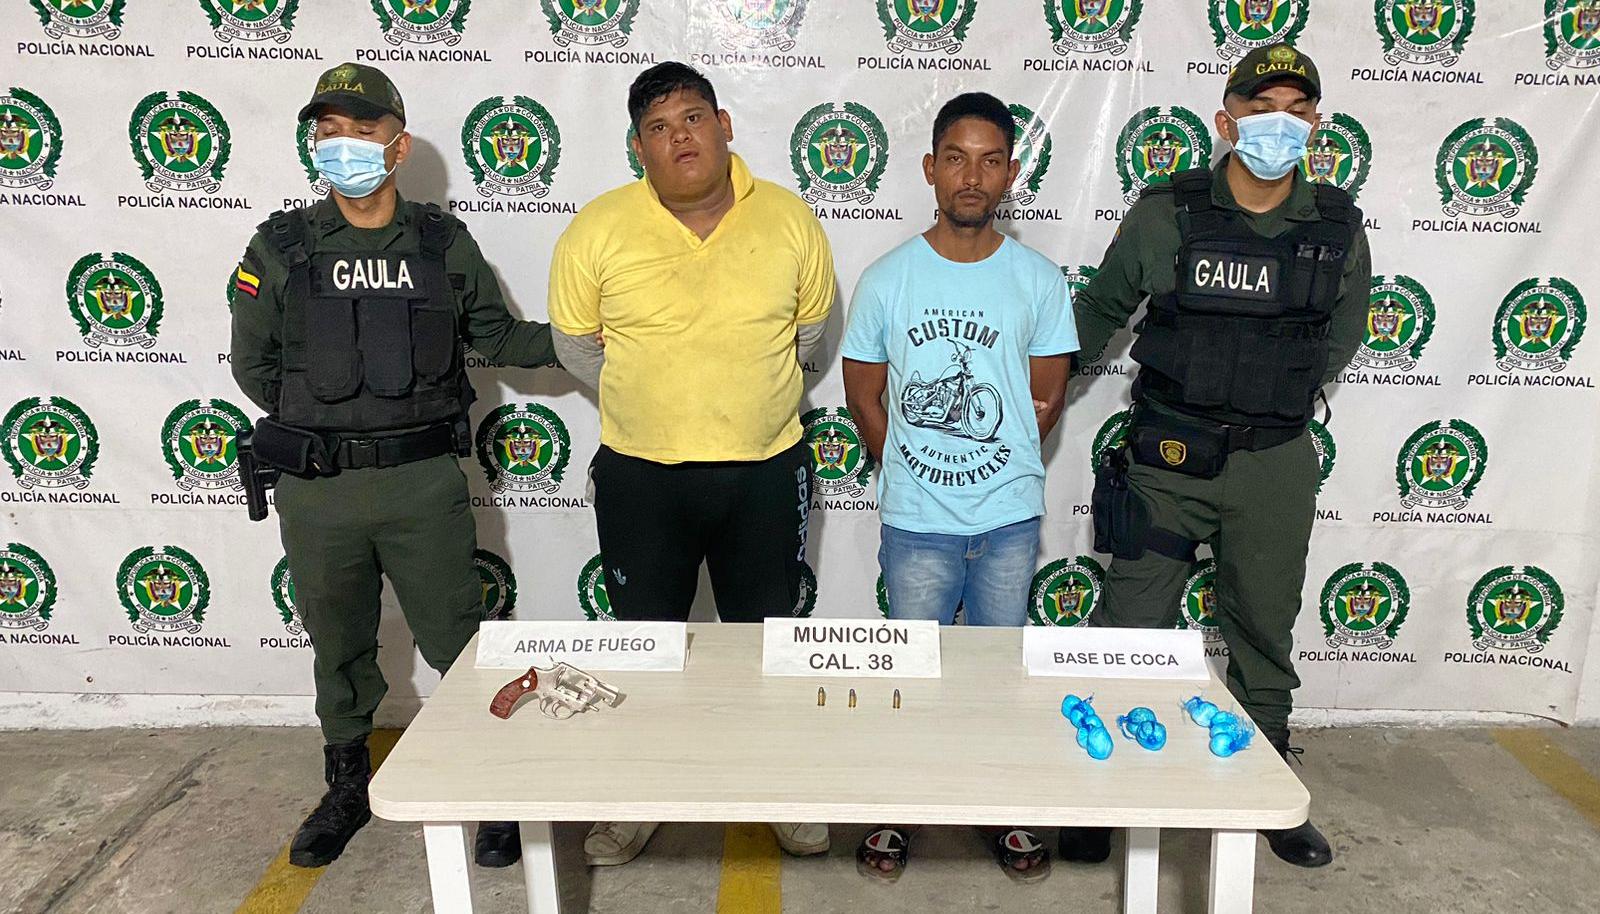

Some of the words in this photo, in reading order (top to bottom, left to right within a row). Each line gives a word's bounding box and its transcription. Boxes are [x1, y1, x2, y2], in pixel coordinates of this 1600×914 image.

[18, 38, 76, 55] POLICÍA
[79, 44, 154, 57] NACIONAL
[187, 41, 245, 58] POLICÍA
[248, 47, 323, 60] NACIONAL
[356, 47, 415, 61] POLICÍA
[419, 50, 491, 61] NACIONAL
[525, 48, 581, 62] POLICÍA
[585, 52, 660, 66] NACIONAL
[858, 53, 914, 69] POLICÍA
[918, 58, 991, 70] NACIONAL
[1024, 55, 1079, 71] POLICÍA
[1083, 60, 1154, 72] NACIONAL
[1187, 60, 1234, 74] POLICÍ
[1256, 63, 1306, 75] GAULA
[1351, 67, 1407, 81] POLICÍA
[1412, 71, 1483, 83] NACIONAL
[1515, 73, 1569, 85] POLICÍA
[140, 106, 164, 138] REPUBLICA
[187, 105, 217, 138] COLOMBIA
[474, 110, 499, 142] REPUBLICA
[522, 110, 548, 142] COLOMBIA
[802, 117, 828, 149] REPUBLICA
[851, 116, 876, 149] COLOMBIA
[150, 158, 176, 178] POLICIA
[184, 158, 215, 179] NACIONAL
[481, 164, 506, 182] POLICIA
[514, 163, 544, 183] NACIONAL
[154, 177, 171, 188] DIOS
[186, 178, 212, 188] PATRIA
[808, 170, 832, 189] POLICIA
[840, 169, 871, 190] NACIONAL
[516, 183, 541, 192] PATRIA
[810, 188, 826, 198] DIOS
[842, 190, 866, 200] PATRIA
[12, 194, 86, 206] NACIONAL
[118, 194, 175, 208] POLICÍA
[179, 197, 251, 209] NACIONAL
[447, 200, 504, 214] POLICÍA
[508, 202, 578, 213] NACIONAL
[832, 208, 903, 220] NACIONAL
[993, 209, 1062, 220] NACIONAL
[1412, 218, 1467, 232] POLICÍA
[1472, 222, 1541, 233] NACIONAL
[333, 260, 413, 290] GAULA
[1194, 259, 1270, 293] GAULA
[924, 308, 984, 318] AMERICAN
[907, 318, 1000, 349] CUSTOM
[56, 351, 112, 362] POLICÍA
[116, 352, 187, 363] NACIONAL
[1079, 365, 1126, 376] CIONAL
[1333, 372, 1368, 384] LICÍA
[1373, 374, 1441, 385] NACIONAL
[1468, 371, 1520, 385] POLICÍA
[1524, 376, 1595, 387] NACIONAL
[11, 410, 36, 439] REPUBLICA
[921, 445, 988, 463] AUTHENTIC
[20, 459, 45, 476] POLICIA
[55, 457, 83, 476] NACIONAL
[900, 444, 1011, 486] MOTORCYCLES
[25, 475, 41, 484] DIOS
[57, 475, 81, 485] PATRIA
[1, 492, 46, 502] OLICÍA
[49, 493, 120, 503] NACIONAL
[151, 492, 204, 504] POLICÍA
[208, 495, 274, 505] NACIOL
[472, 496, 516, 508] OLICÍA
[520, 496, 590, 507] NACIONAL
[1373, 510, 1422, 522] POLICÍA
[1427, 513, 1492, 523] NACIONAL
[11, 634, 79, 644] NACIONAL
[109, 634, 160, 646] POLICÍA
[163, 637, 231, 647] NACIONAL
[794, 624, 907, 644] MUNICIÓN
[261, 637, 311, 648] POLICÍA
[514, 640, 566, 653] ARMA
[572, 639, 593, 652] DE
[599, 638, 655, 651] FUEGO
[810, 653, 859, 669] CAL.
[868, 654, 893, 670] 38
[1054, 653, 1098, 664] BASE
[1104, 653, 1126, 665] DE
[1131, 654, 1179, 665] COCA
[1299, 649, 1348, 661] POLICÍA
[1352, 652, 1416, 662] NACIONAL
[1445, 650, 1495, 663] POLICÍA
[1499, 655, 1572, 673] NACIONAL
